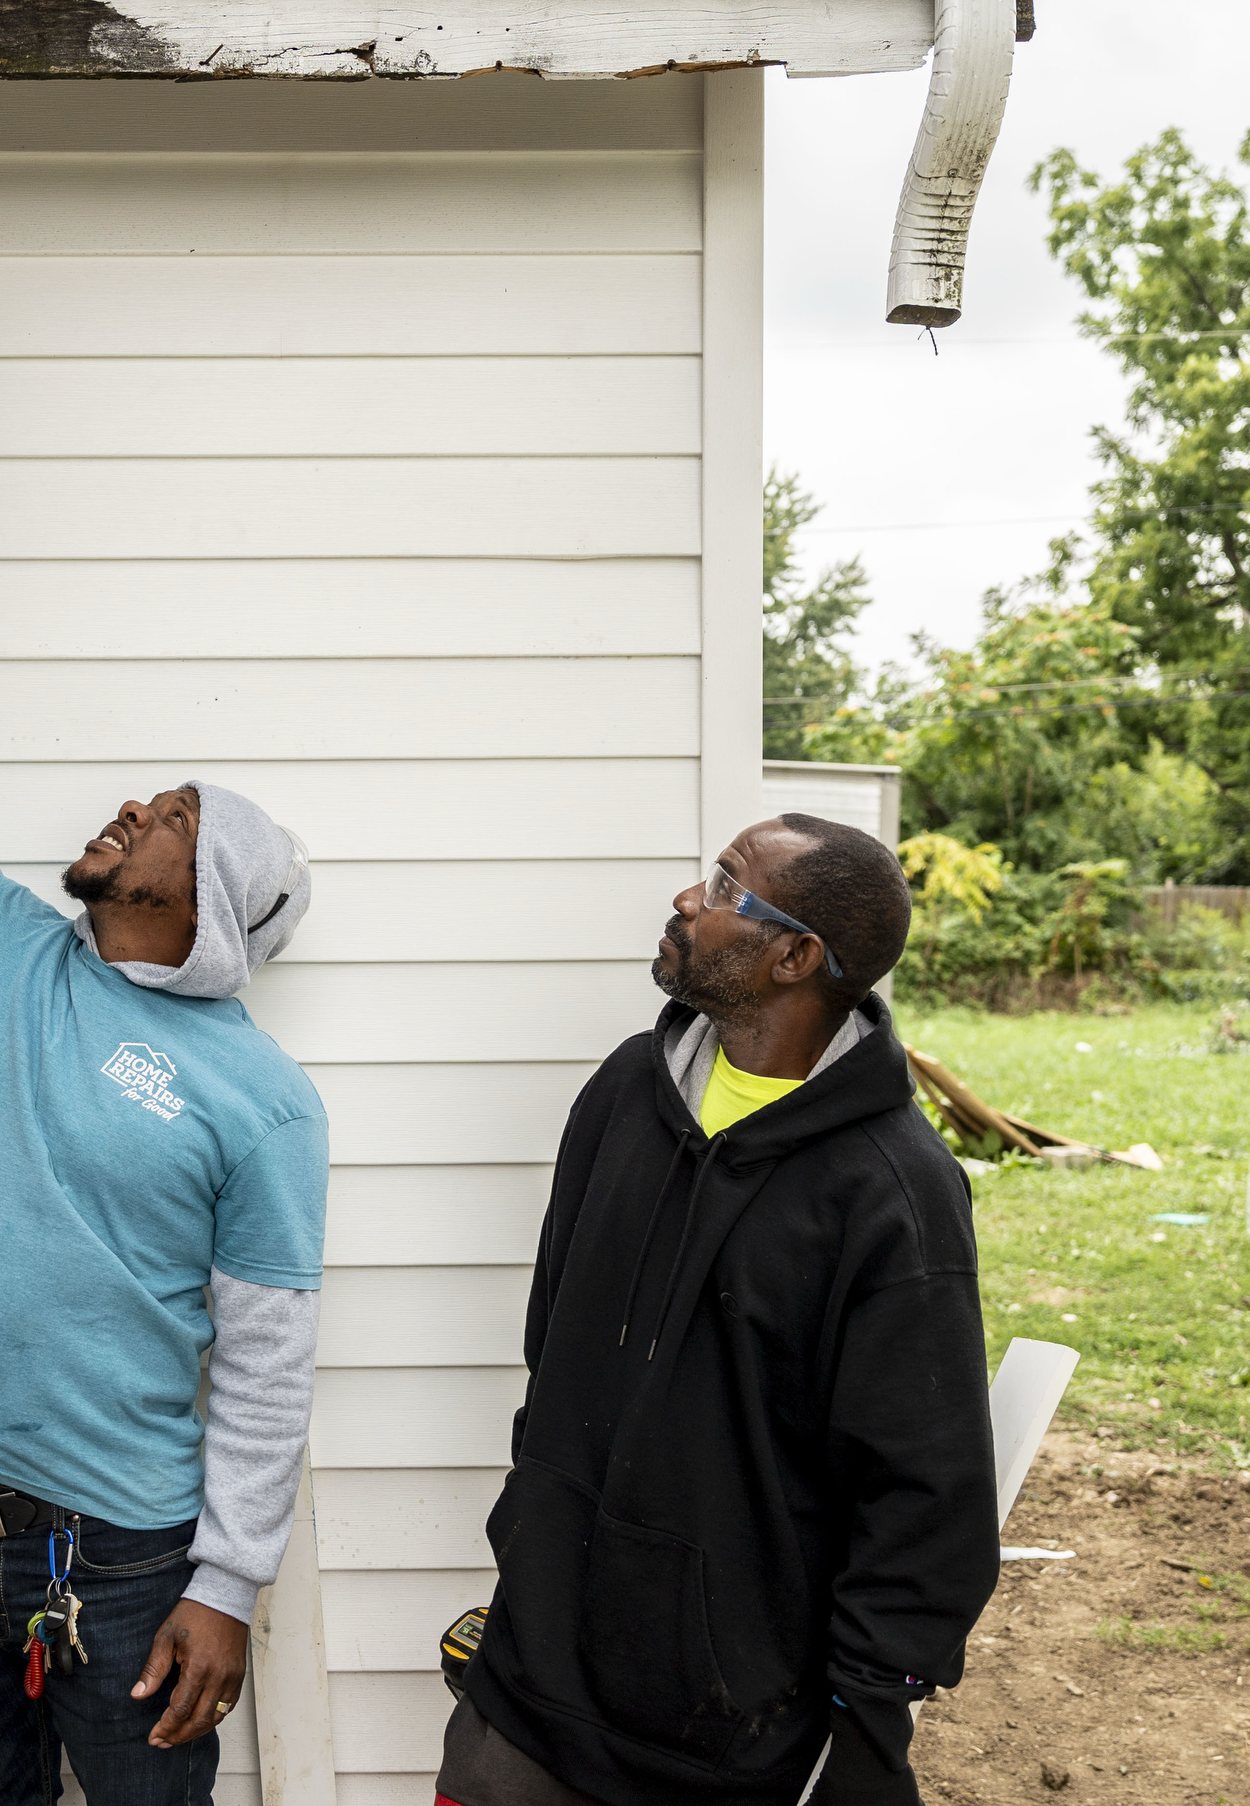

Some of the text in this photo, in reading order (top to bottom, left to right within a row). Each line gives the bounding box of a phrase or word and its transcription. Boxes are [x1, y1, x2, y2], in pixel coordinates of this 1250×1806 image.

[109, 1061, 185, 1111] REPAIRS
[118, 1050, 174, 1088] HOME
[120, 1087, 181, 1121] for Good
